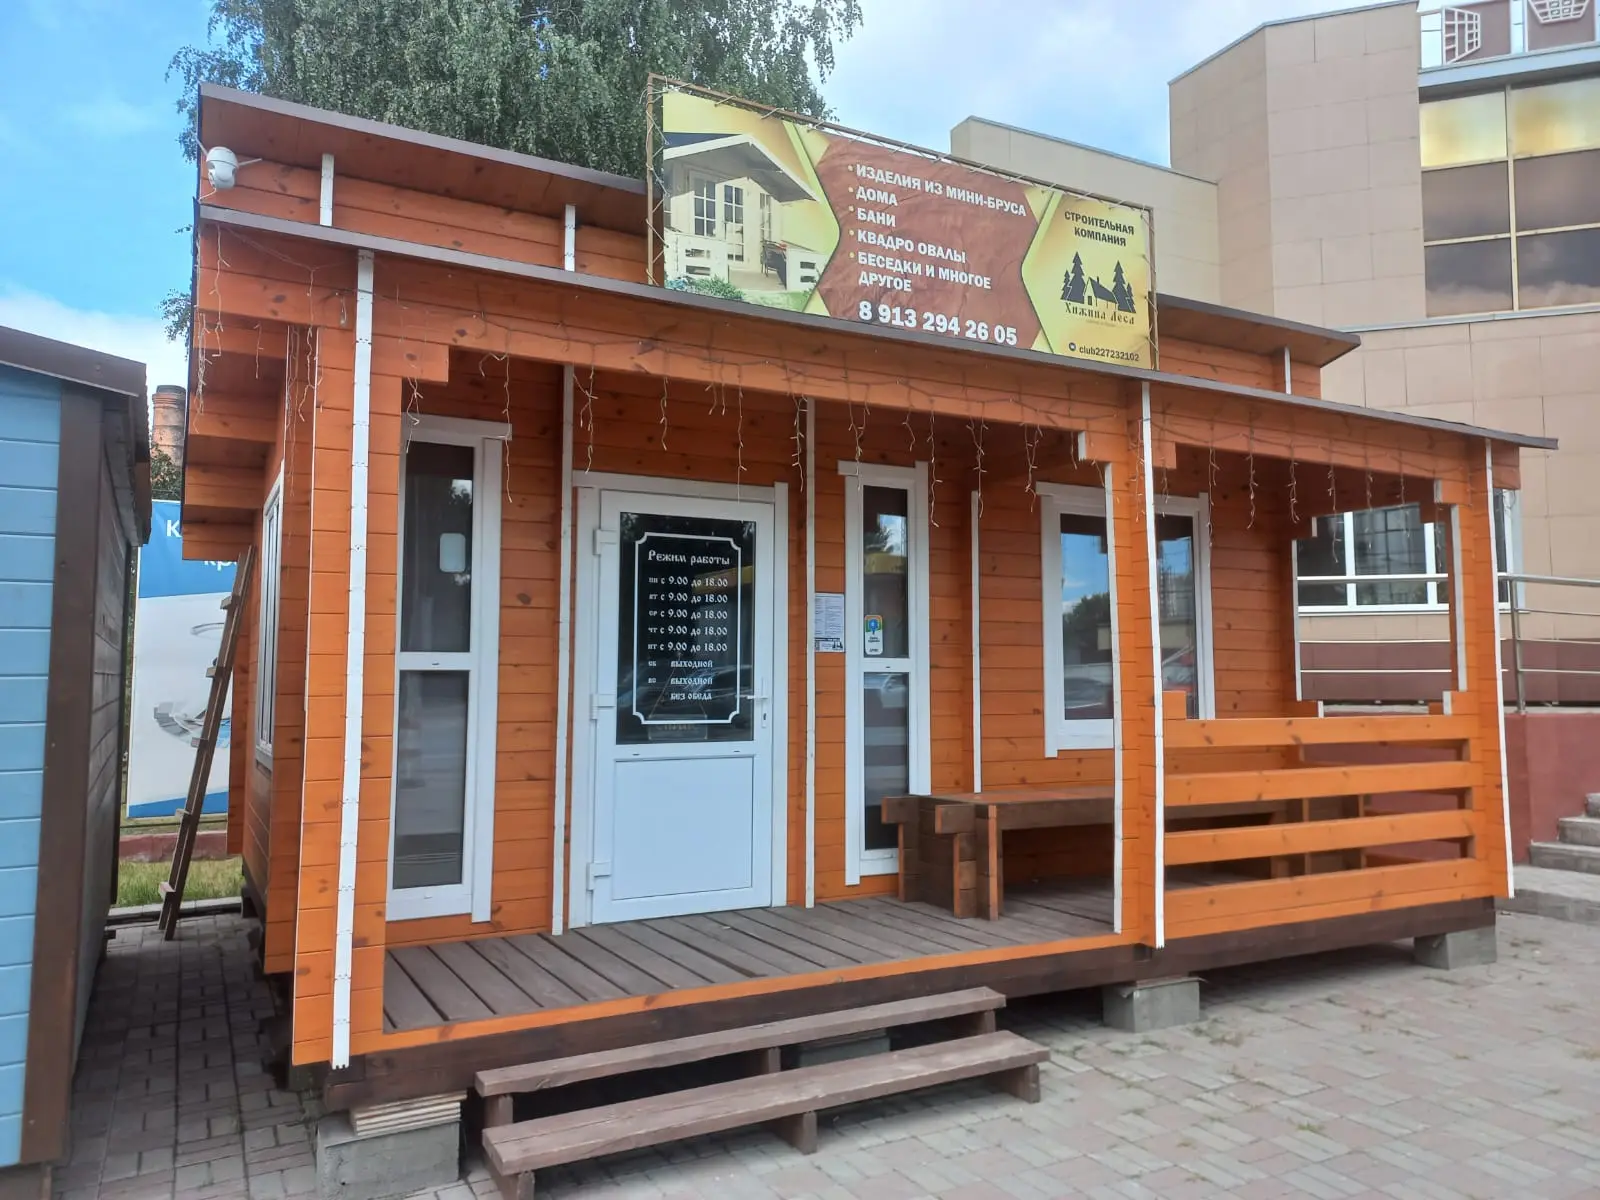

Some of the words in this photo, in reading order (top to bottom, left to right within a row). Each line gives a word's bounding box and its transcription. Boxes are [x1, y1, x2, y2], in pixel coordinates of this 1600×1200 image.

[856, 164, 921, 190] ИЗДЕЛИЯ
[924, 180, 943, 195] ИЗ
[946, 185, 1027, 217] МИНИ-БРУСА
[856, 186, 898, 206] ДОМА
[857, 208, 896, 227] БАНИ
[1065, 211, 1134, 235] СТРОИТЕЛЬНАЯ
[857, 229, 914, 252] КВАДРО
[918, 242, 966, 263] ОВАЛЫ
[1074, 227, 1126, 247] КОМПАНИЯ
[858, 251, 922, 275] БЕСЕДКИ
[926, 264, 935, 278] И
[938, 267, 991, 289] МНОГОЕ
[858, 271, 912, 292] ДРУГОЕ
[859, 300, 873, 321] 8
[878, 304, 917, 328] 913
[922, 311, 960, 336] 294
[965, 319, 989, 341] 26
[994, 325, 1017, 346] 05
[1065, 302, 1106, 320] Хижина
[1111, 311, 1134, 325] Леса
[1079, 345, 1139, 361] club227232102
[648, 550, 687, 563] Режим
[690, 555, 730, 566] работы
[668, 576, 688, 585] 9.00
[691, 579, 701, 588] до
[705, 578, 728, 587] 18.00
[668, 592, 688, 601] 9.00
[691, 595, 701, 604] до
[705, 594, 728, 603] 18.00
[668, 609, 688, 618] 9.00
[691, 612, 701, 620] до
[705, 610, 728, 619] 18.00
[668, 625, 688, 635] 9.00
[690, 628, 701, 637] до
[705, 626, 727, 636] 18.00
[667, 642, 687, 651] 9.00
[690, 645, 701, 653] до
[704, 643, 727, 652] 18.00
